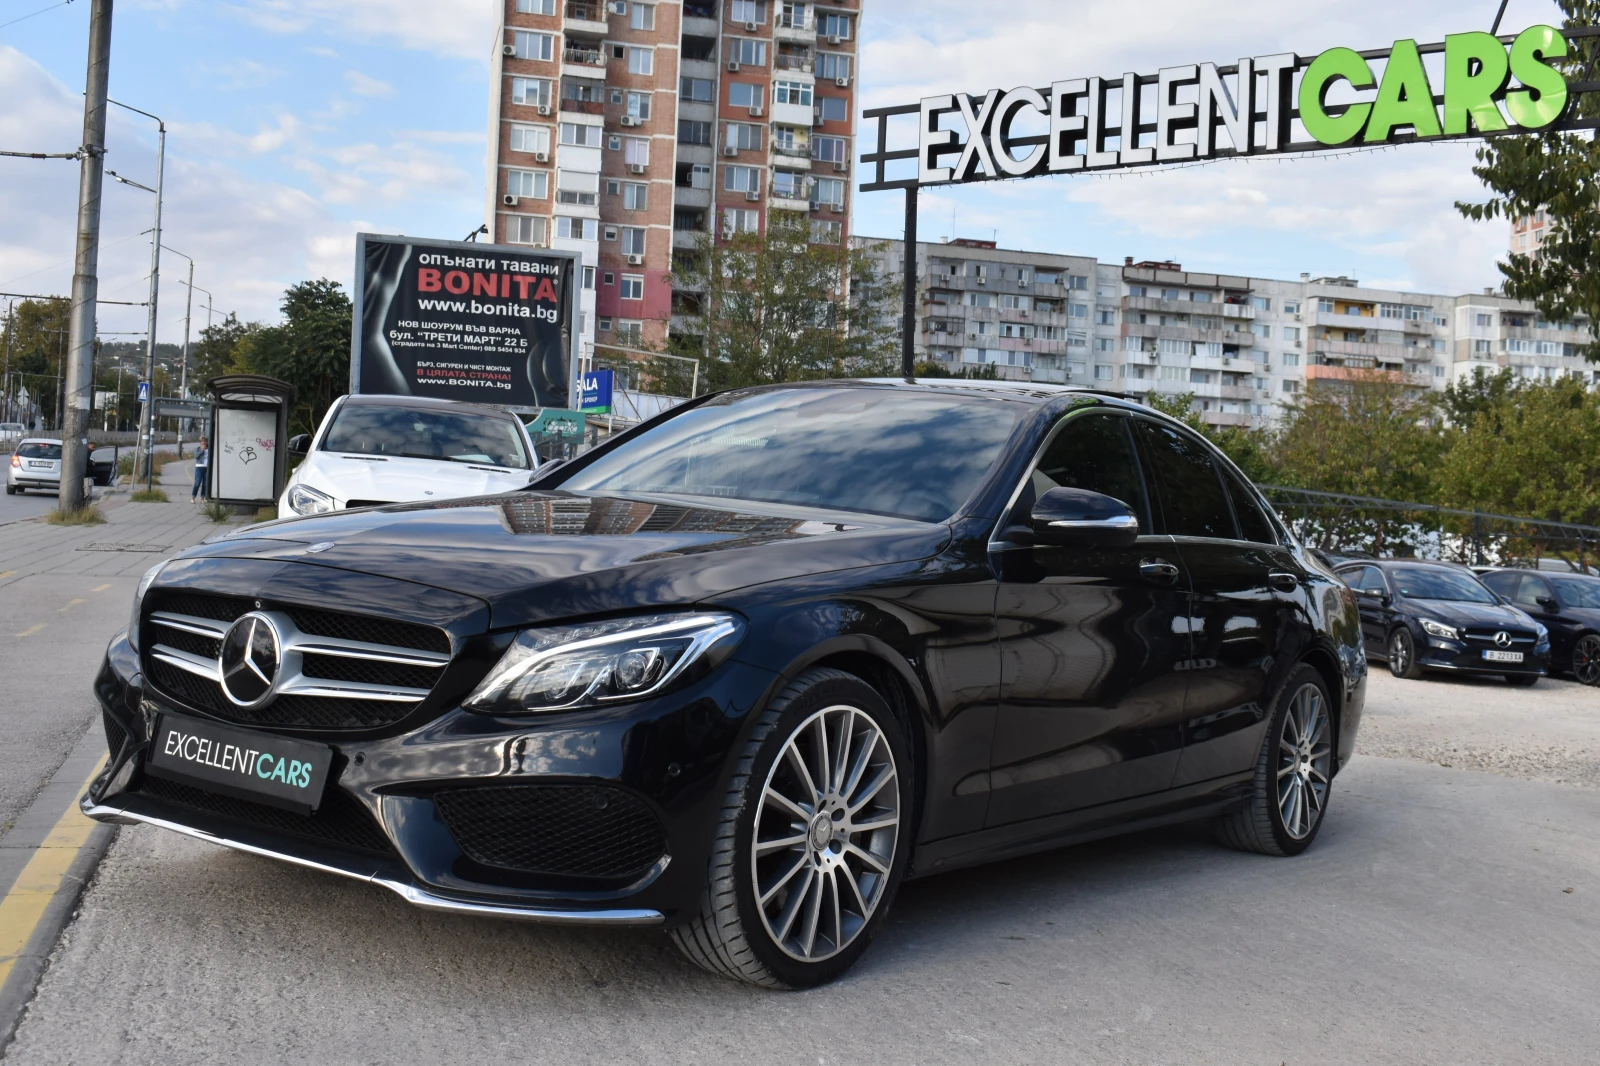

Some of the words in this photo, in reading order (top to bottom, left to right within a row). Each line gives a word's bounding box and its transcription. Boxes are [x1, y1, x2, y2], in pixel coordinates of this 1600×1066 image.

[419, 253, 496, 270] опънати
[501, 260, 559, 275] тавани
[418, 267, 557, 303] BONITA
[418, 299, 558, 323] www.bonita.bg
[398, 320, 419, 328] НОВ
[421, 321, 463, 331] ШОУРУМ
[465, 325, 487, 333] ВЪВ
[488, 326, 521, 335] ВАРНА
[389, 330, 414, 341] бул.
[504, 337, 517, 346] 22
[520, 338, 528, 347] Б
[458, 343, 483, 351] Center)
[436, 362, 463, 370] СИГУРЕН
[417, 368, 424, 376] В
[426, 369, 467, 378] ЦЯЛАТА
[469, 371, 511, 380] СТРАНА!
[417, 378, 511, 390] www.BONITA.bg
